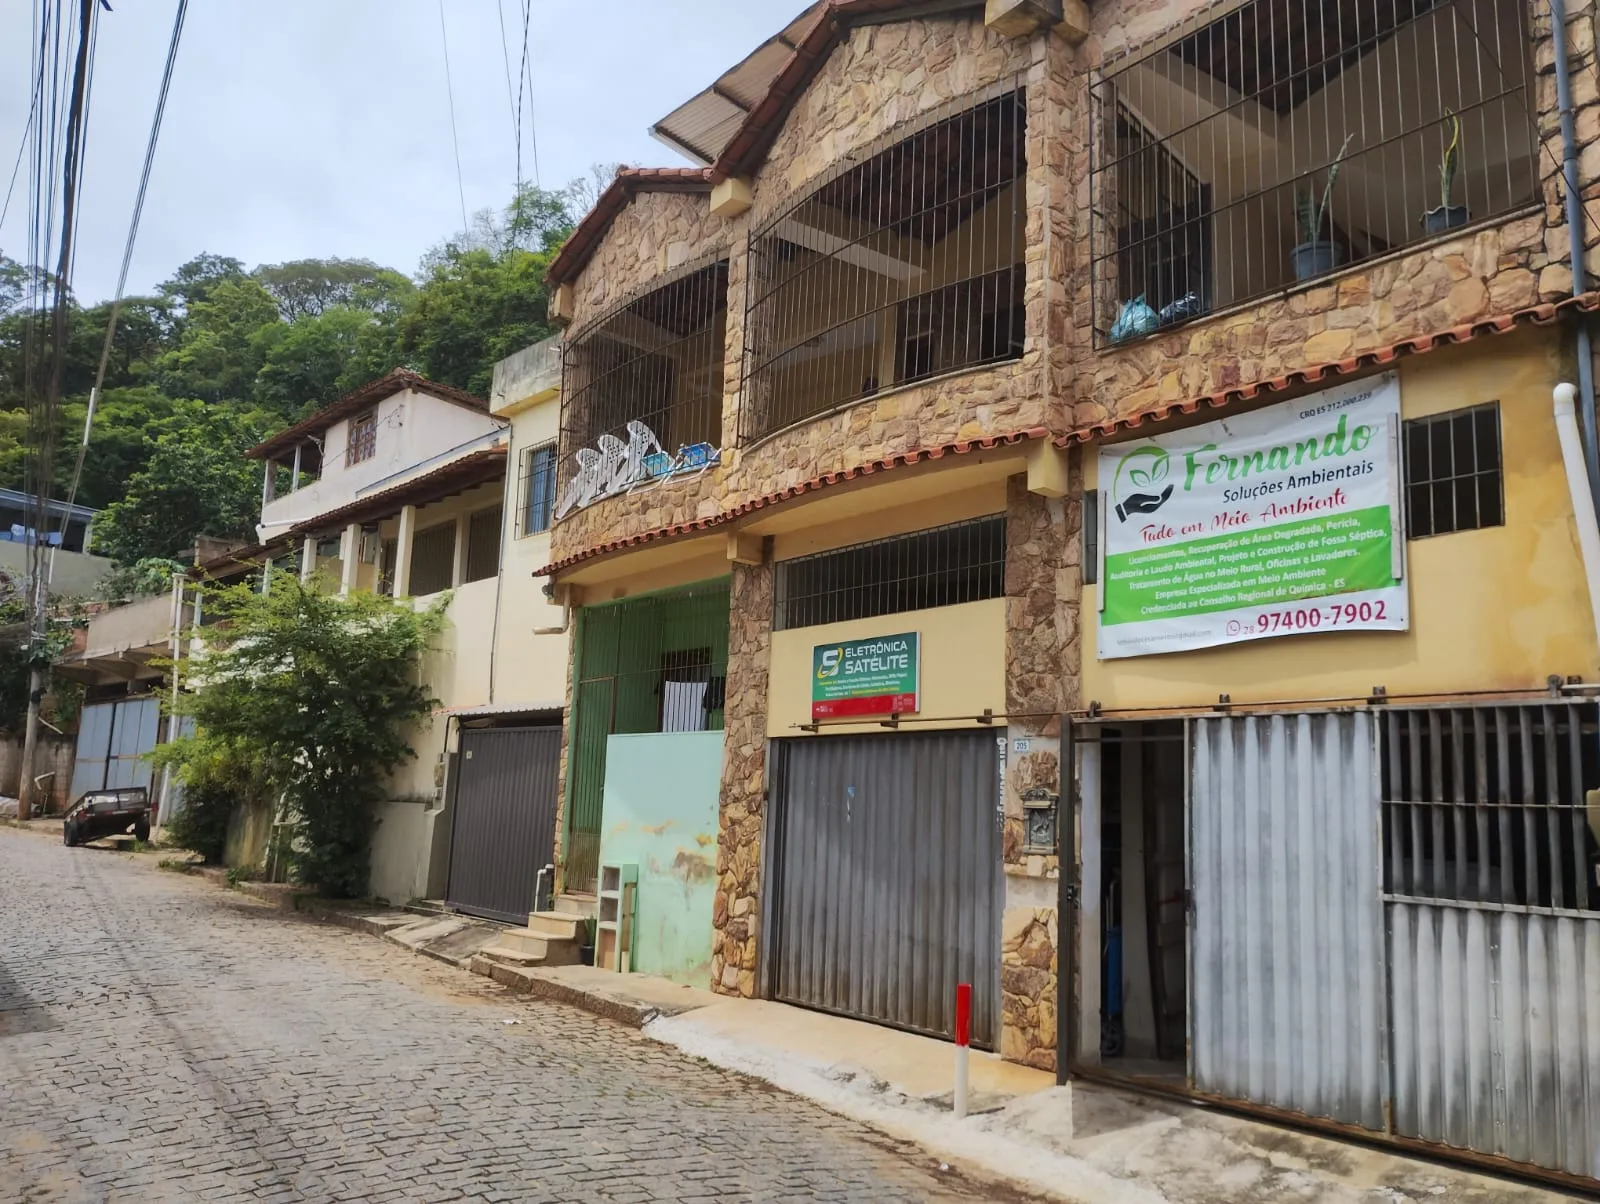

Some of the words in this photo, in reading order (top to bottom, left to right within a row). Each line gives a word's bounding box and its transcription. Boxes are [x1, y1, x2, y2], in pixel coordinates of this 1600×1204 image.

[1317, 406, 1326, 415] ES
[1182, 413, 1378, 491] Fernando
[1223, 481, 1283, 503] Soluções
[1287, 460, 1374, 490] Ambientais
[1140, 524, 1175, 544] Tudo
[1181, 522, 1204, 535] em
[1211, 510, 1250, 530] Meio
[1260, 488, 1347, 522] Ambiente
[1110, 568, 1143, 580] Auditoria
[1150, 563, 1173, 574] Laudo
[1218, 550, 1248, 563] Projeto
[1257, 542, 1306, 557] Construção
[1308, 540, 1319, 548] de
[1321, 535, 1347, 546] Fossa
[1188, 539, 1238, 555] Recuperação
[1240, 537, 1250, 546] de
[1252, 534, 1272, 545] Área
[1155, 590, 1188, 600] Empresa
[1189, 581, 1241, 596] Especializada
[1242, 579, 1256, 587] em
[1258, 574, 1280, 585] Meio
[1282, 567, 1326, 580] Ambiente
[1172, 575, 1182, 584] de
[1183, 571, 1203, 584] Água
[1205, 571, 1216, 579] no
[1217, 566, 1239, 577] Meio
[1266, 556, 1301, 569] Oficinas
[1140, 600, 1187, 615] Credenciada
[1199, 593, 1236, 607] Conselho
[1237, 588, 1274, 602] Regional
[1276, 587, 1287, 595] de
[1289, 581, 1326, 595] Química
[1334, 578, 1345, 588] ES
[1243, 625, 1254, 635] 28
[1257, 600, 1387, 634] 97400-7902
[845, 641, 908, 658] ELETRÔNICA
[845, 654, 908, 675] SATÉLITE
[1016, 741, 1028, 751] 205
